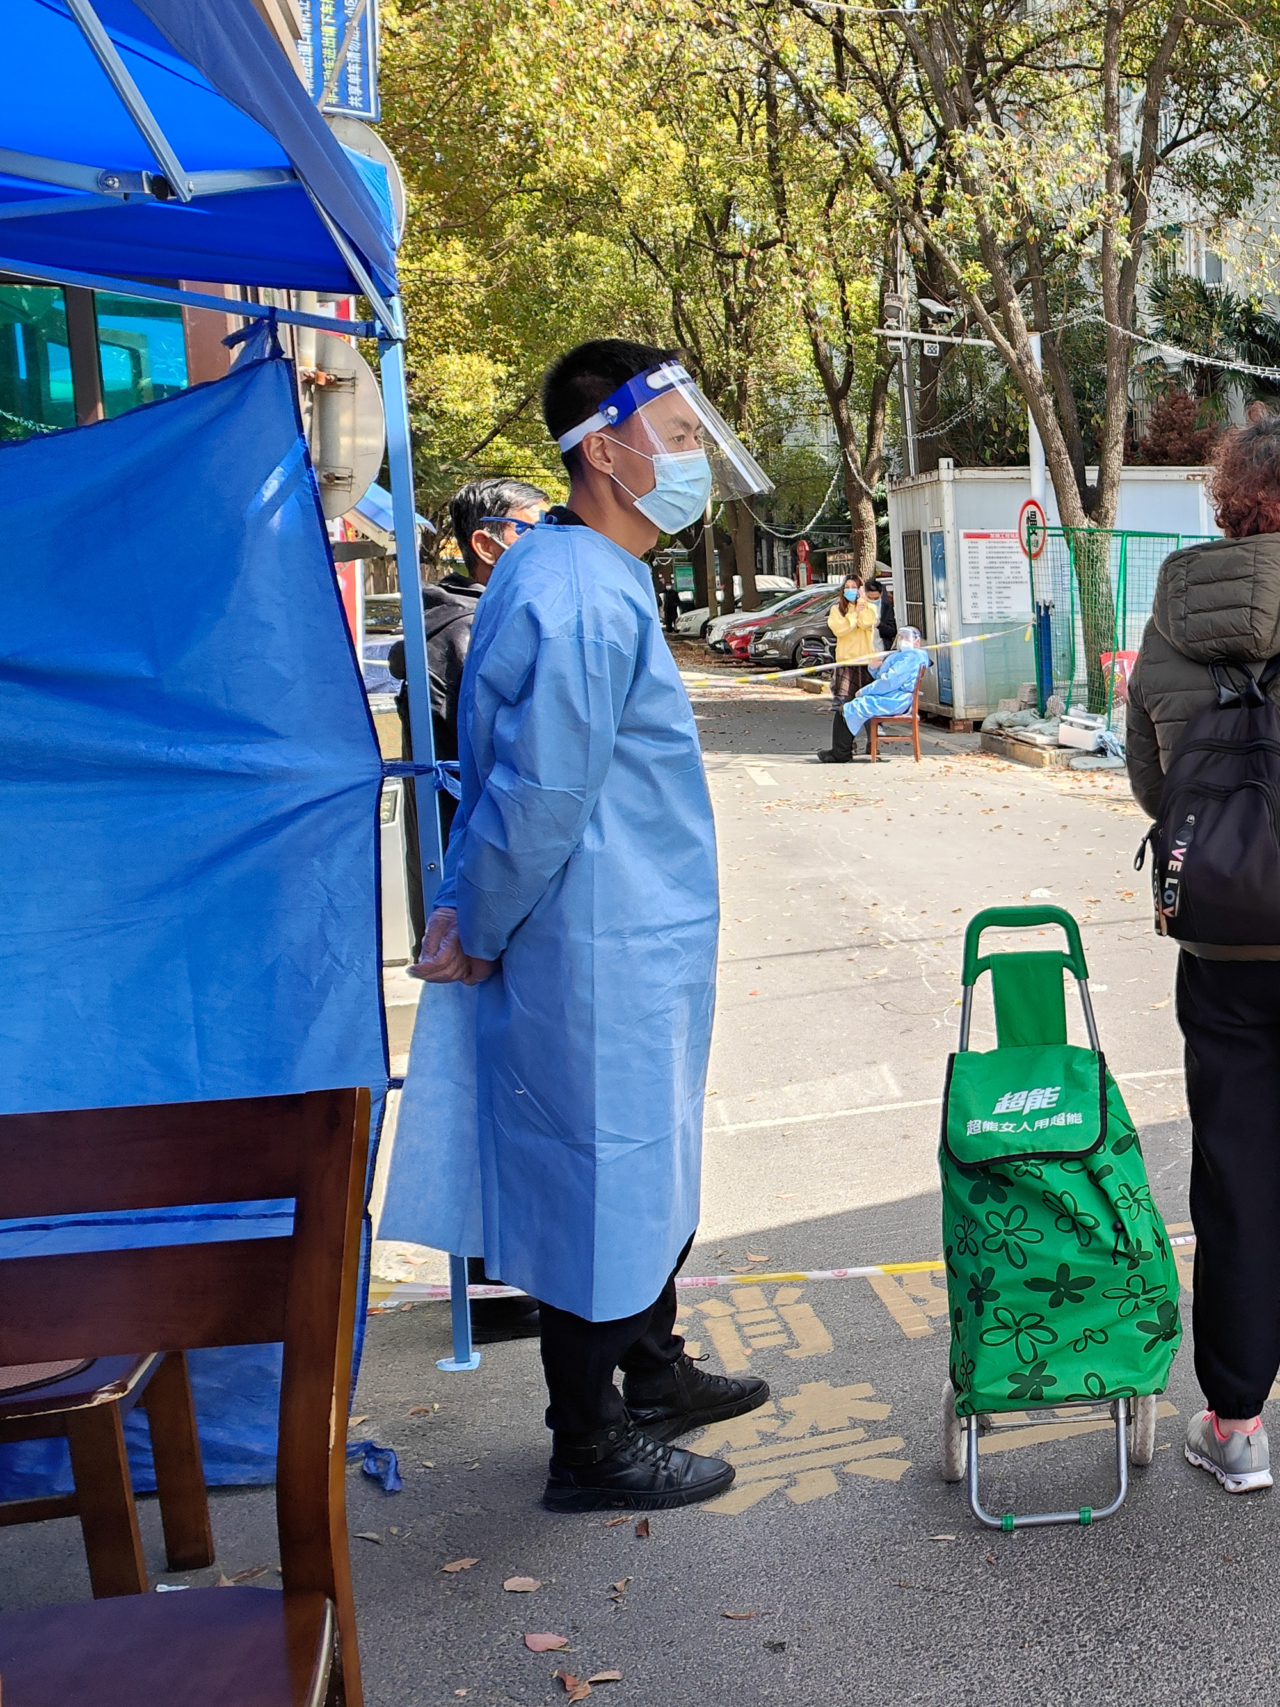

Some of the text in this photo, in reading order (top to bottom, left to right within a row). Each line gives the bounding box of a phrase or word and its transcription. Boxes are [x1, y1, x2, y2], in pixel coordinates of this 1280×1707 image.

[992, 1086, 1062, 1116] 超能
[966, 1112, 1084, 1137] 超能女人用超能
